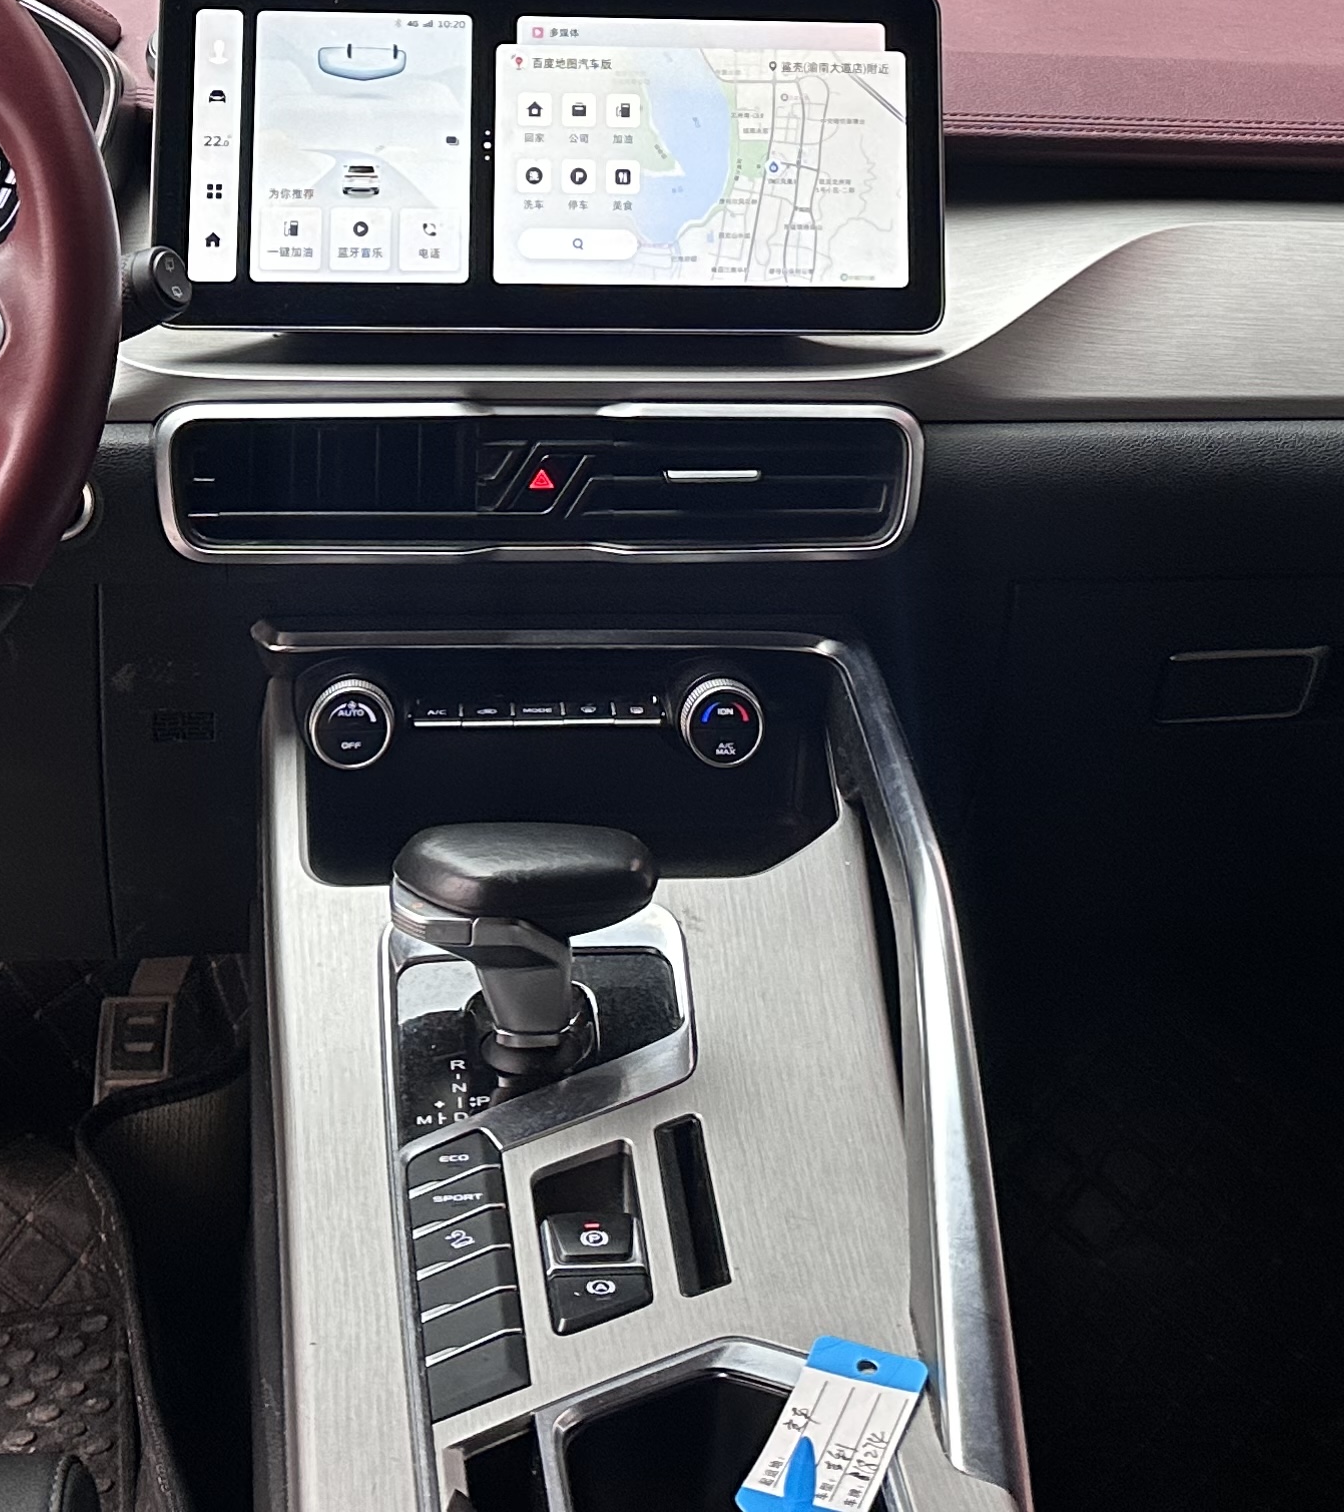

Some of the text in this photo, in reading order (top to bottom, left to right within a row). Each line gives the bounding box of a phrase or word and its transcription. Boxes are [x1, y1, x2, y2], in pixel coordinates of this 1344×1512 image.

[438, 20, 466, 29] 10:20
[549, 28, 579, 38] 多媒体
[532, 57, 612, 70] 百度地图汽车版
[524, 133, 545, 143] 回家
[569, 134, 589, 144] 公司
[613, 134, 633, 144] 加油
[269, 188, 314, 199] 为你推荐
[524, 200, 544, 209] 洗车
[568, 200, 588, 210] 停车
[613, 201, 632, 210] 美食
[267, 247, 313, 258] 一键加油
[337, 247, 383, 258] 蓝牙音乐
[419, 248, 440, 259] 电话
[337, 708, 365, 717] AUTO
[427, 708, 447, 716] A/C
[717, 707, 734, 716] ION
[341, 741, 362, 750] OFF
[450, 1059, 466, 1070] R
[452, 1082, 467, 1093] N
[477, 1096, 491, 1107] P
[416, 1114, 433, 1125] M
[454, 1111, 469, 1122] D
[439, 1154, 470, 1163] ECO
[432, 1192, 484, 1204] SPORT
